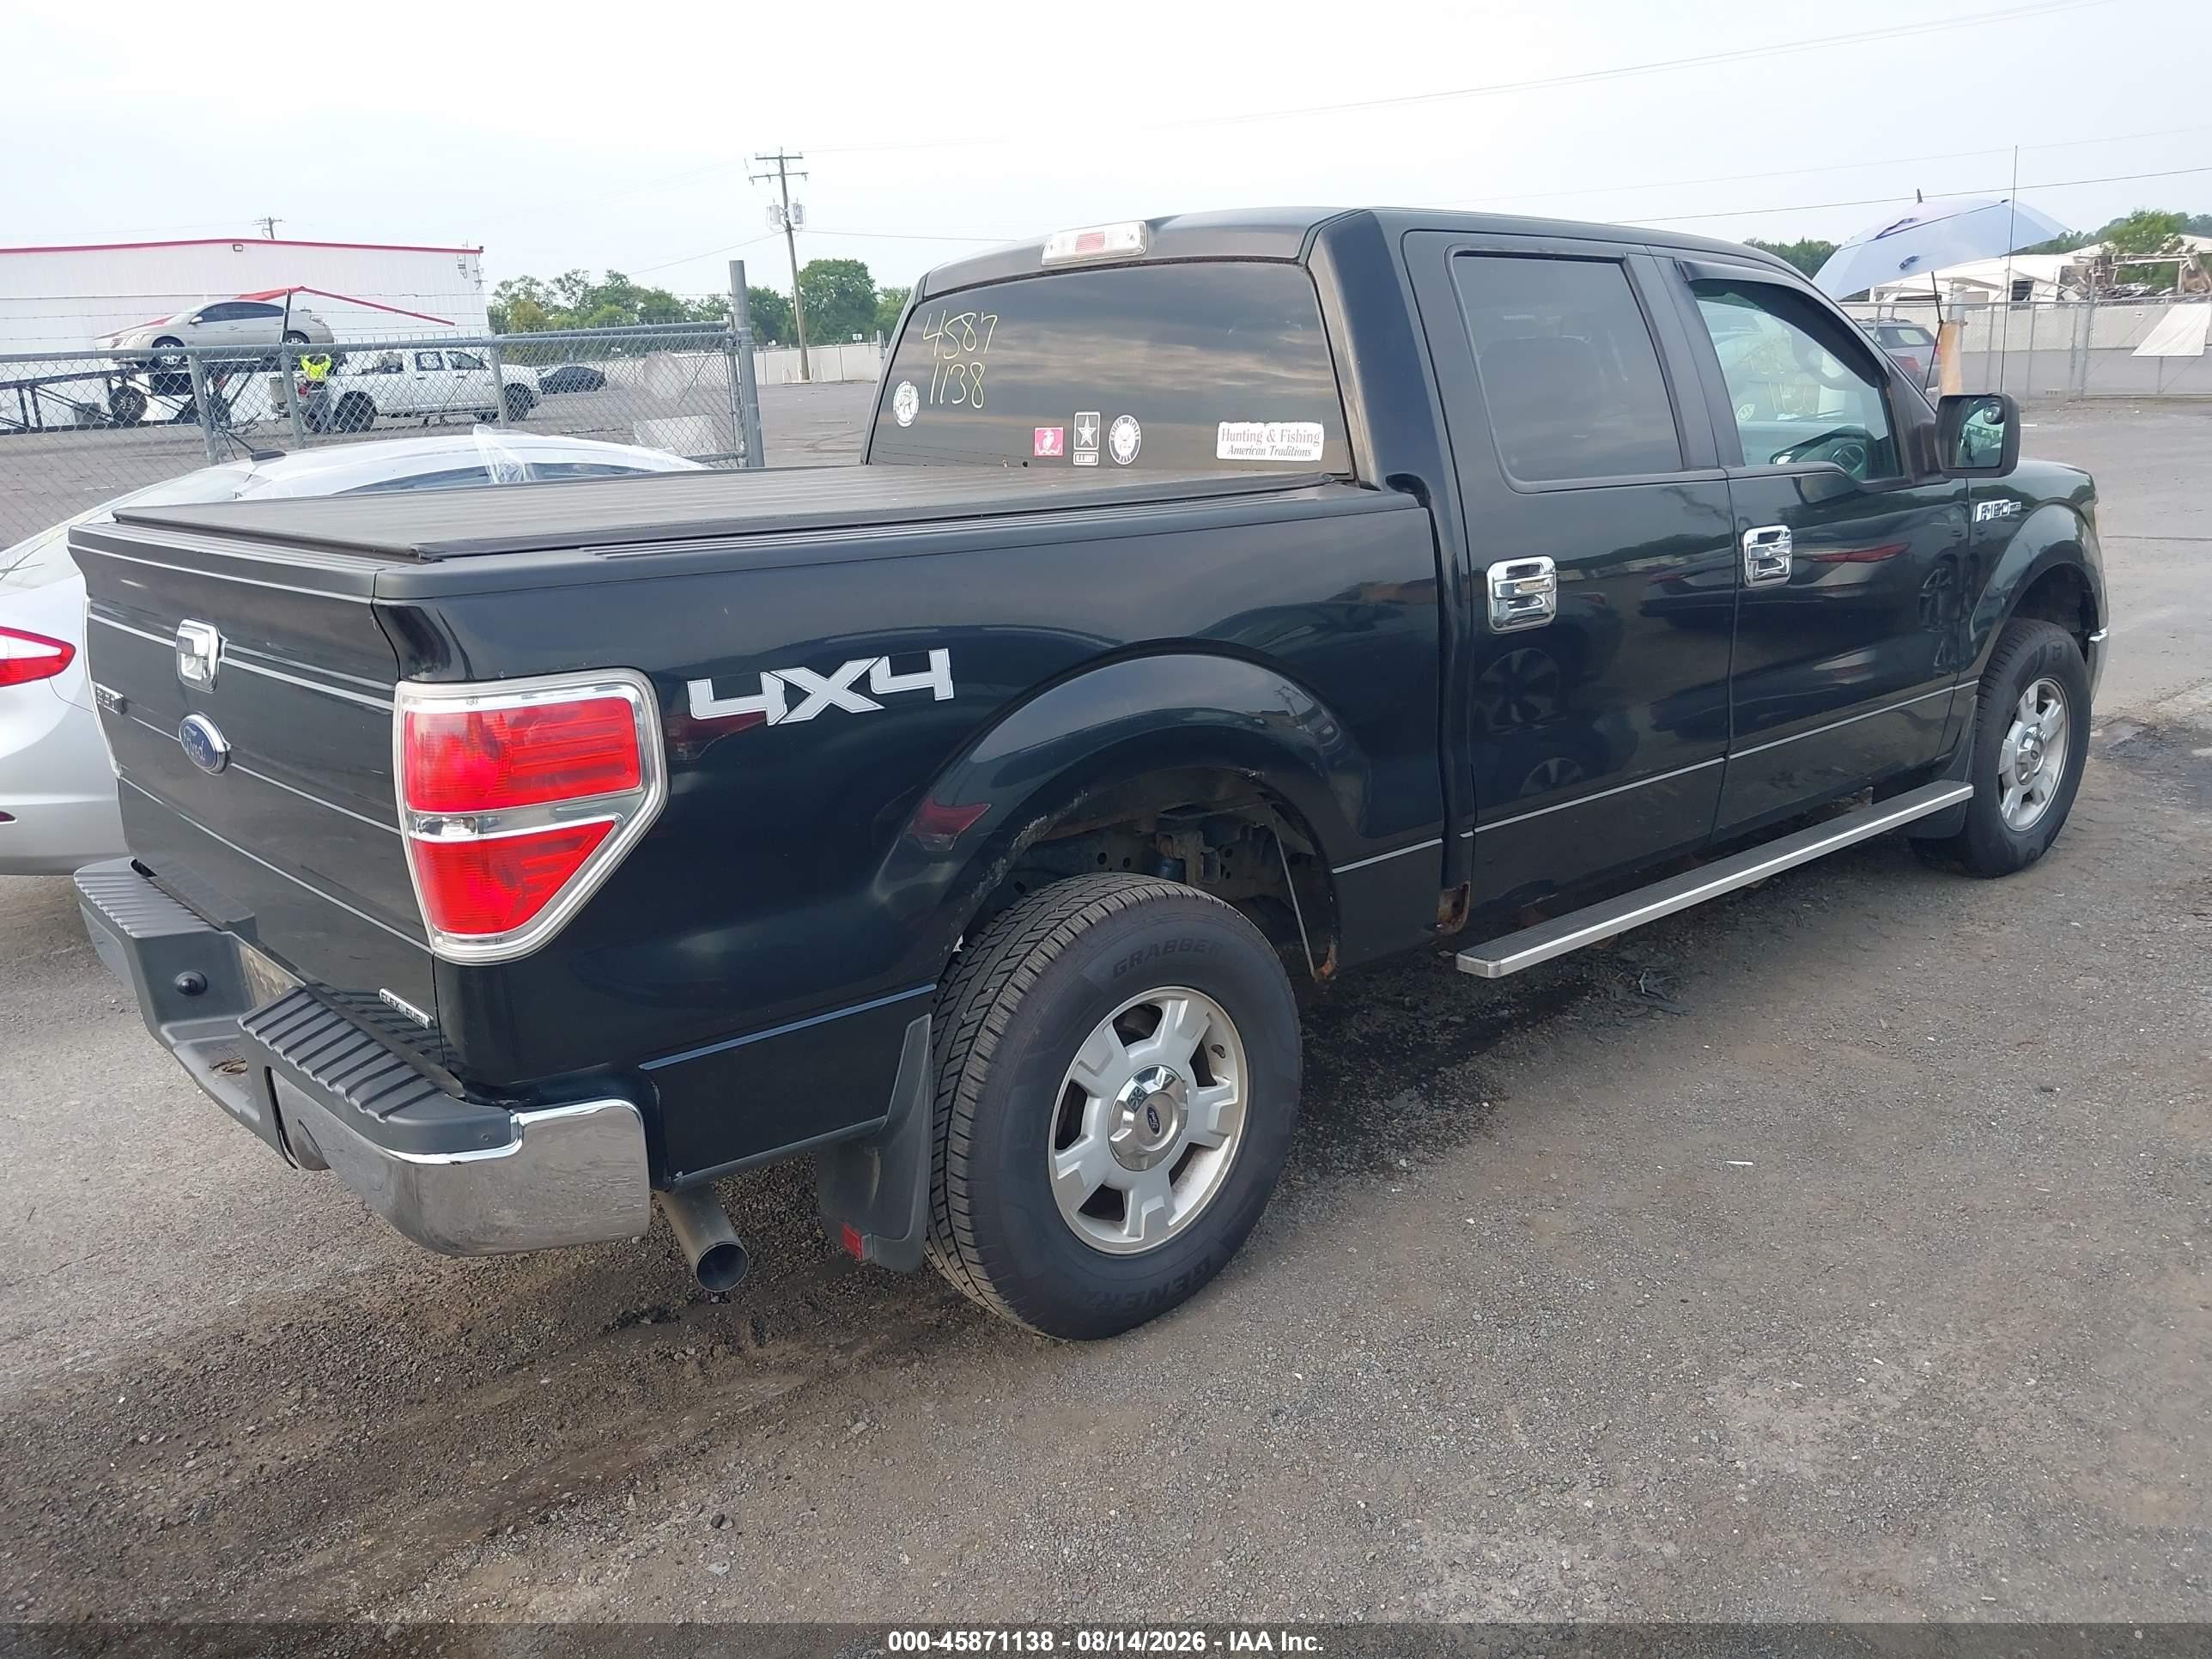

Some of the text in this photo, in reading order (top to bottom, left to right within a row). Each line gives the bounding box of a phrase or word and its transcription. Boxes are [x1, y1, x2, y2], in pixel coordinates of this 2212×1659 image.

[922, 310, 998, 359] 4587
[930, 362, 985, 409] 1138
[1221, 428, 1321, 447] Hunting & Fishing
[1227, 445, 1312, 457] American Traditions
[183, 725, 207, 762] Ford
[381, 992, 426, 1025] FLEX FUEL
